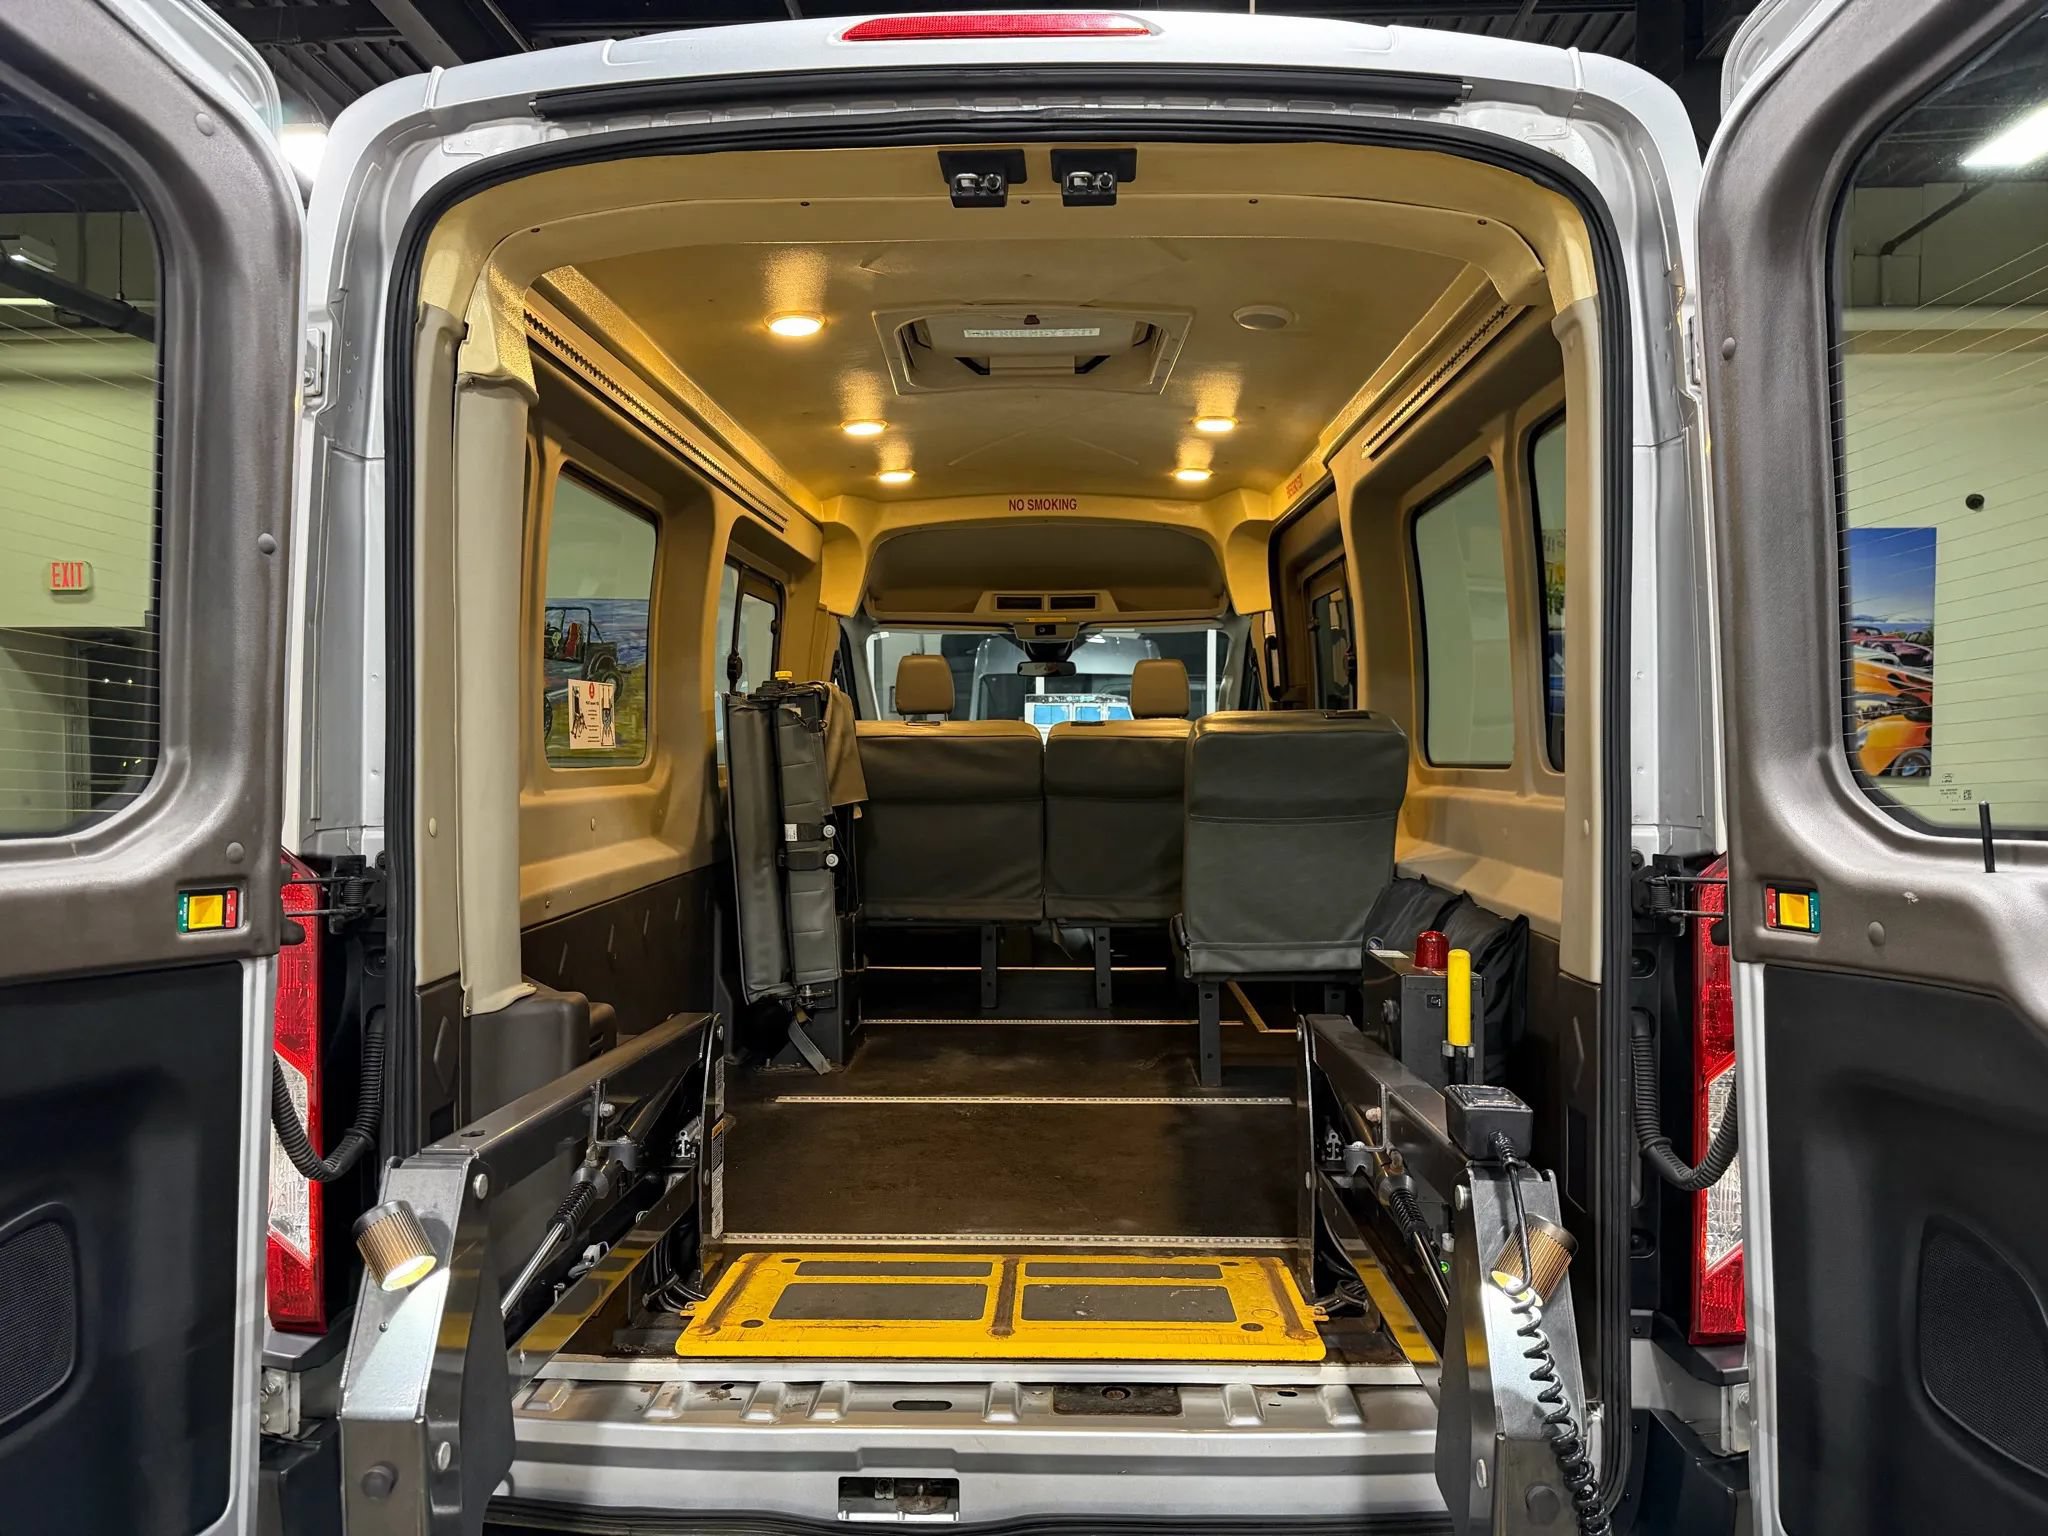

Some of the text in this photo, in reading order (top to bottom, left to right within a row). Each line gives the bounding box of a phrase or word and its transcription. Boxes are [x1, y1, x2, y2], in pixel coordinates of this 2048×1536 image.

[1008, 498, 1077, 511] NO SMOKING
[51, 562, 84, 588] EXIT
